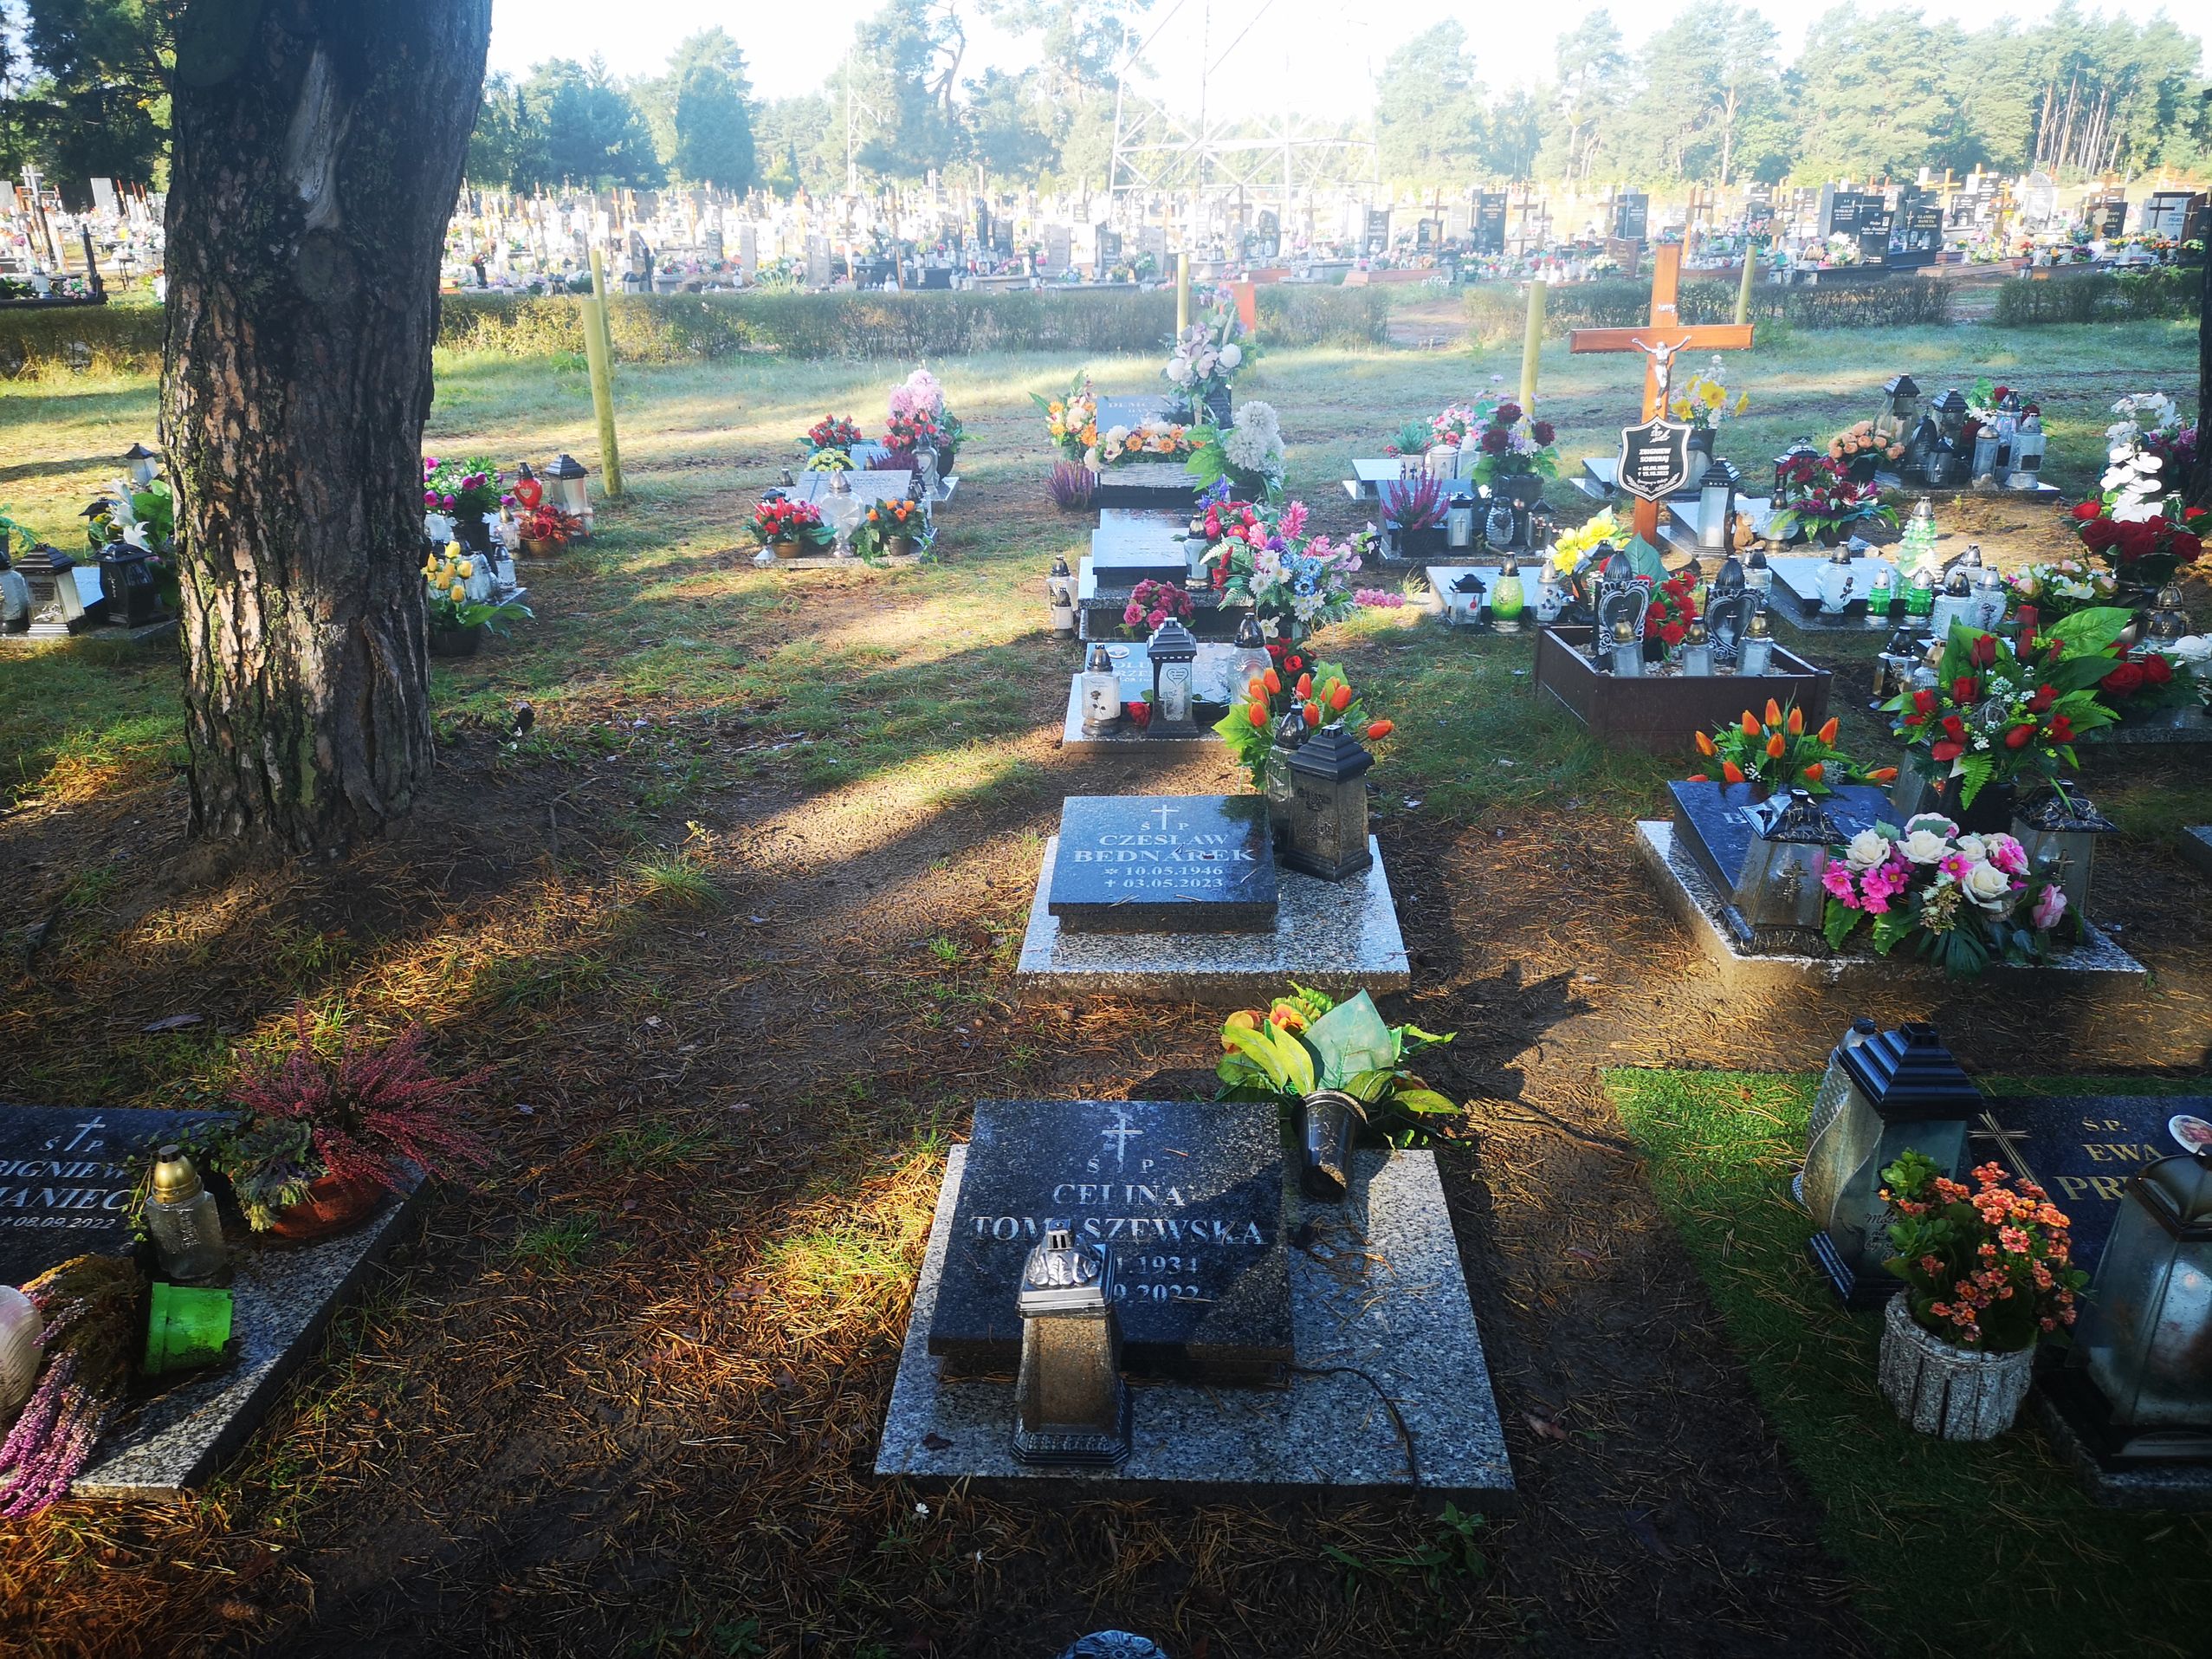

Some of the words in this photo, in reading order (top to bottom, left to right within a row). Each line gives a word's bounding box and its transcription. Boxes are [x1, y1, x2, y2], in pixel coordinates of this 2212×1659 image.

[1179, 822, 1190, 831] P
[1074, 849, 1256, 863] BEDNAREK
[1126, 866, 1223, 875] 10.05.1946
[1122, 878, 1223, 887] 03.05.2023
[83, 1139, 104, 1152] P
[2081, 1144, 2163, 1161] EWA
[1139, 1158, 1155, 1174] P
[1052, 1183, 1186, 1206] CELINA
[969, 1216, 1268, 1245] TOMSZEWSKA
